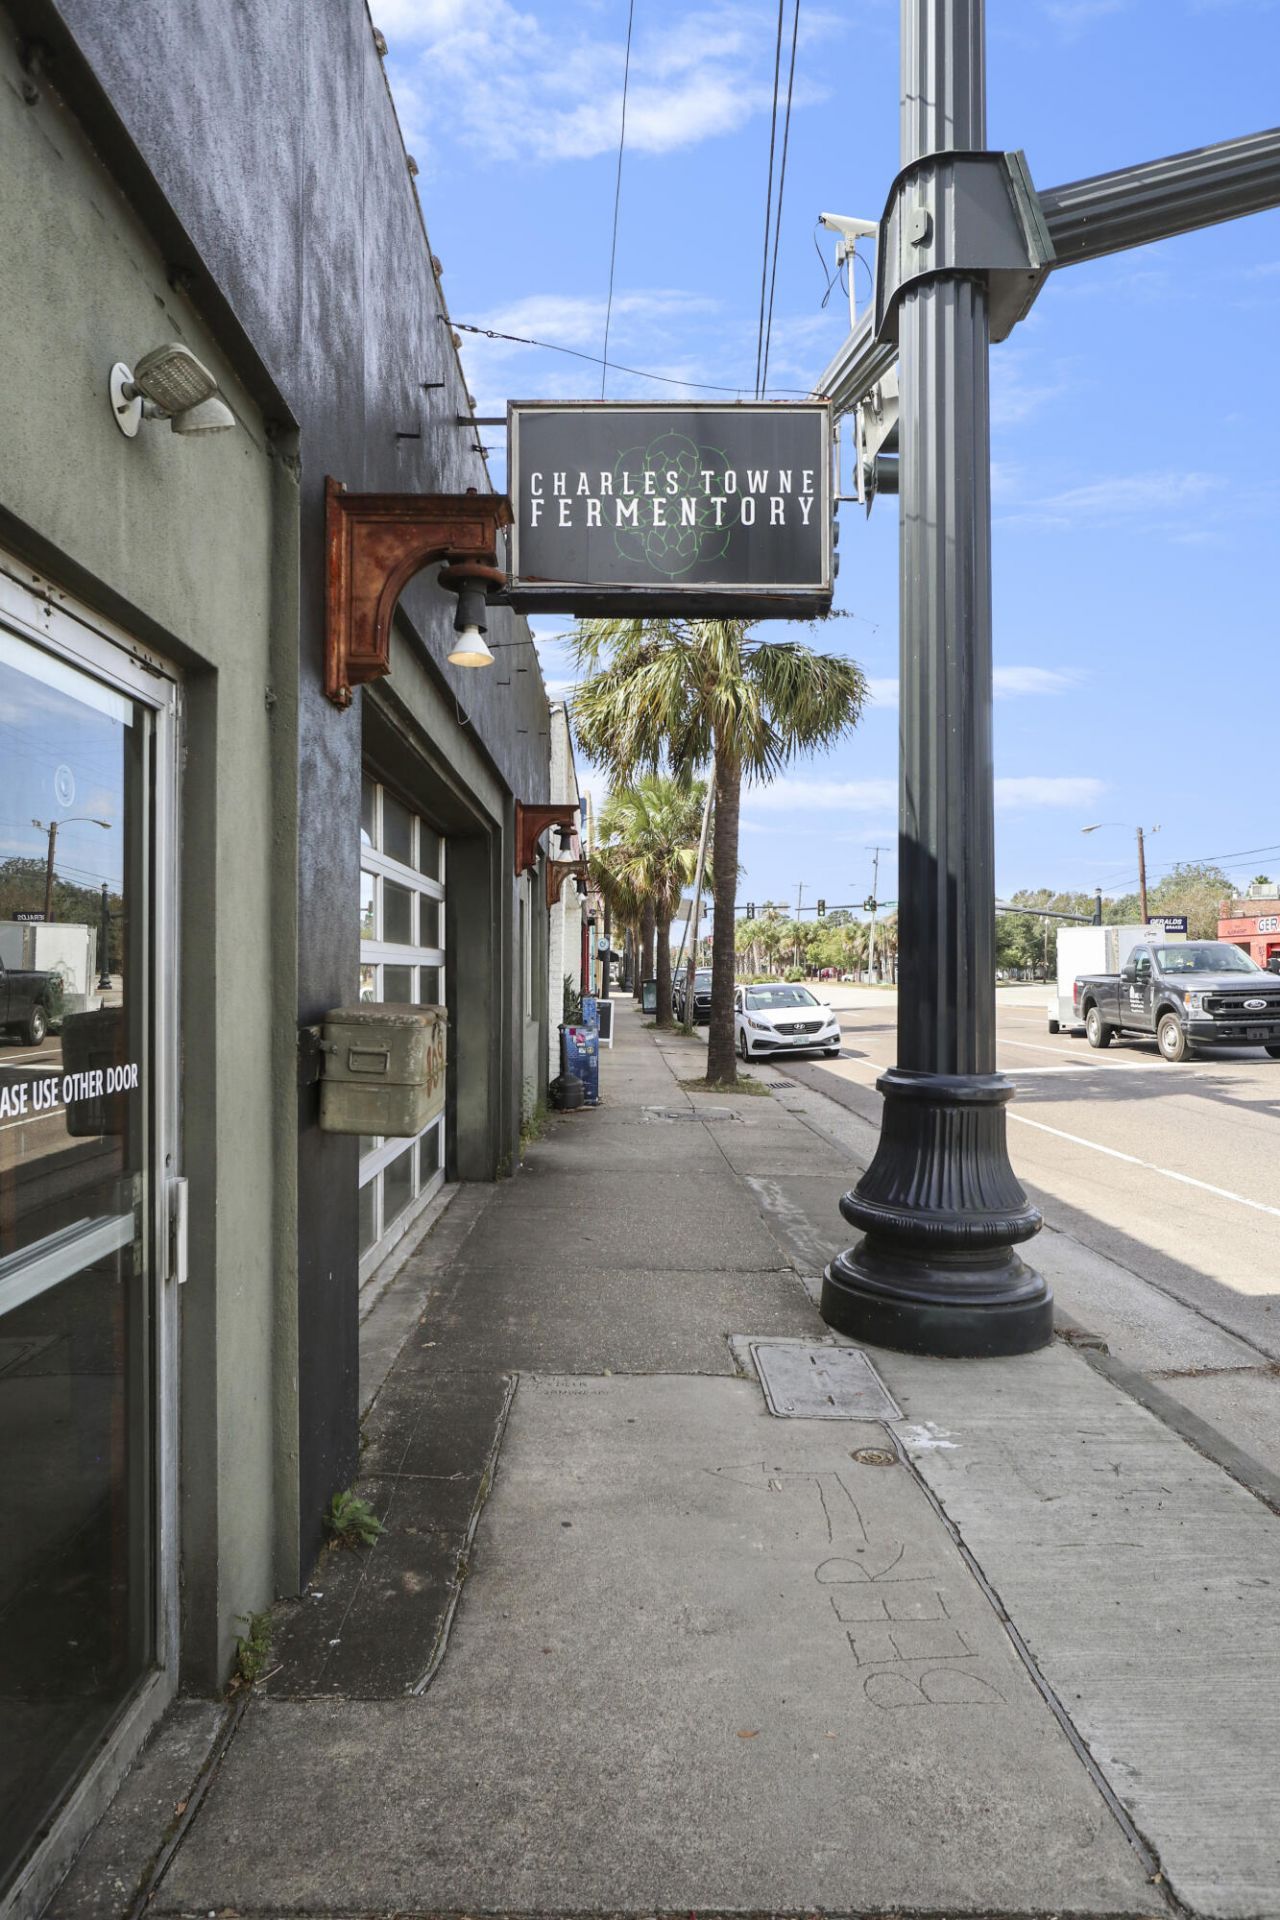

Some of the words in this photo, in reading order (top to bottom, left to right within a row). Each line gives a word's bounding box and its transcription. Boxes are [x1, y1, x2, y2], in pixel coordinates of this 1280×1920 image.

[530, 471, 679, 496] CHARLES
[701, 470, 814, 495] TOWNE
[530, 496, 815, 527] FERMENTORY
[0, 1083, 28, 1118] ASE
[33, 1077, 59, 1111] USE
[62, 1069, 104, 1104] OTHER
[106, 1063, 139, 1094] DOOR
[814, 1544, 1008, 1710] BEER
